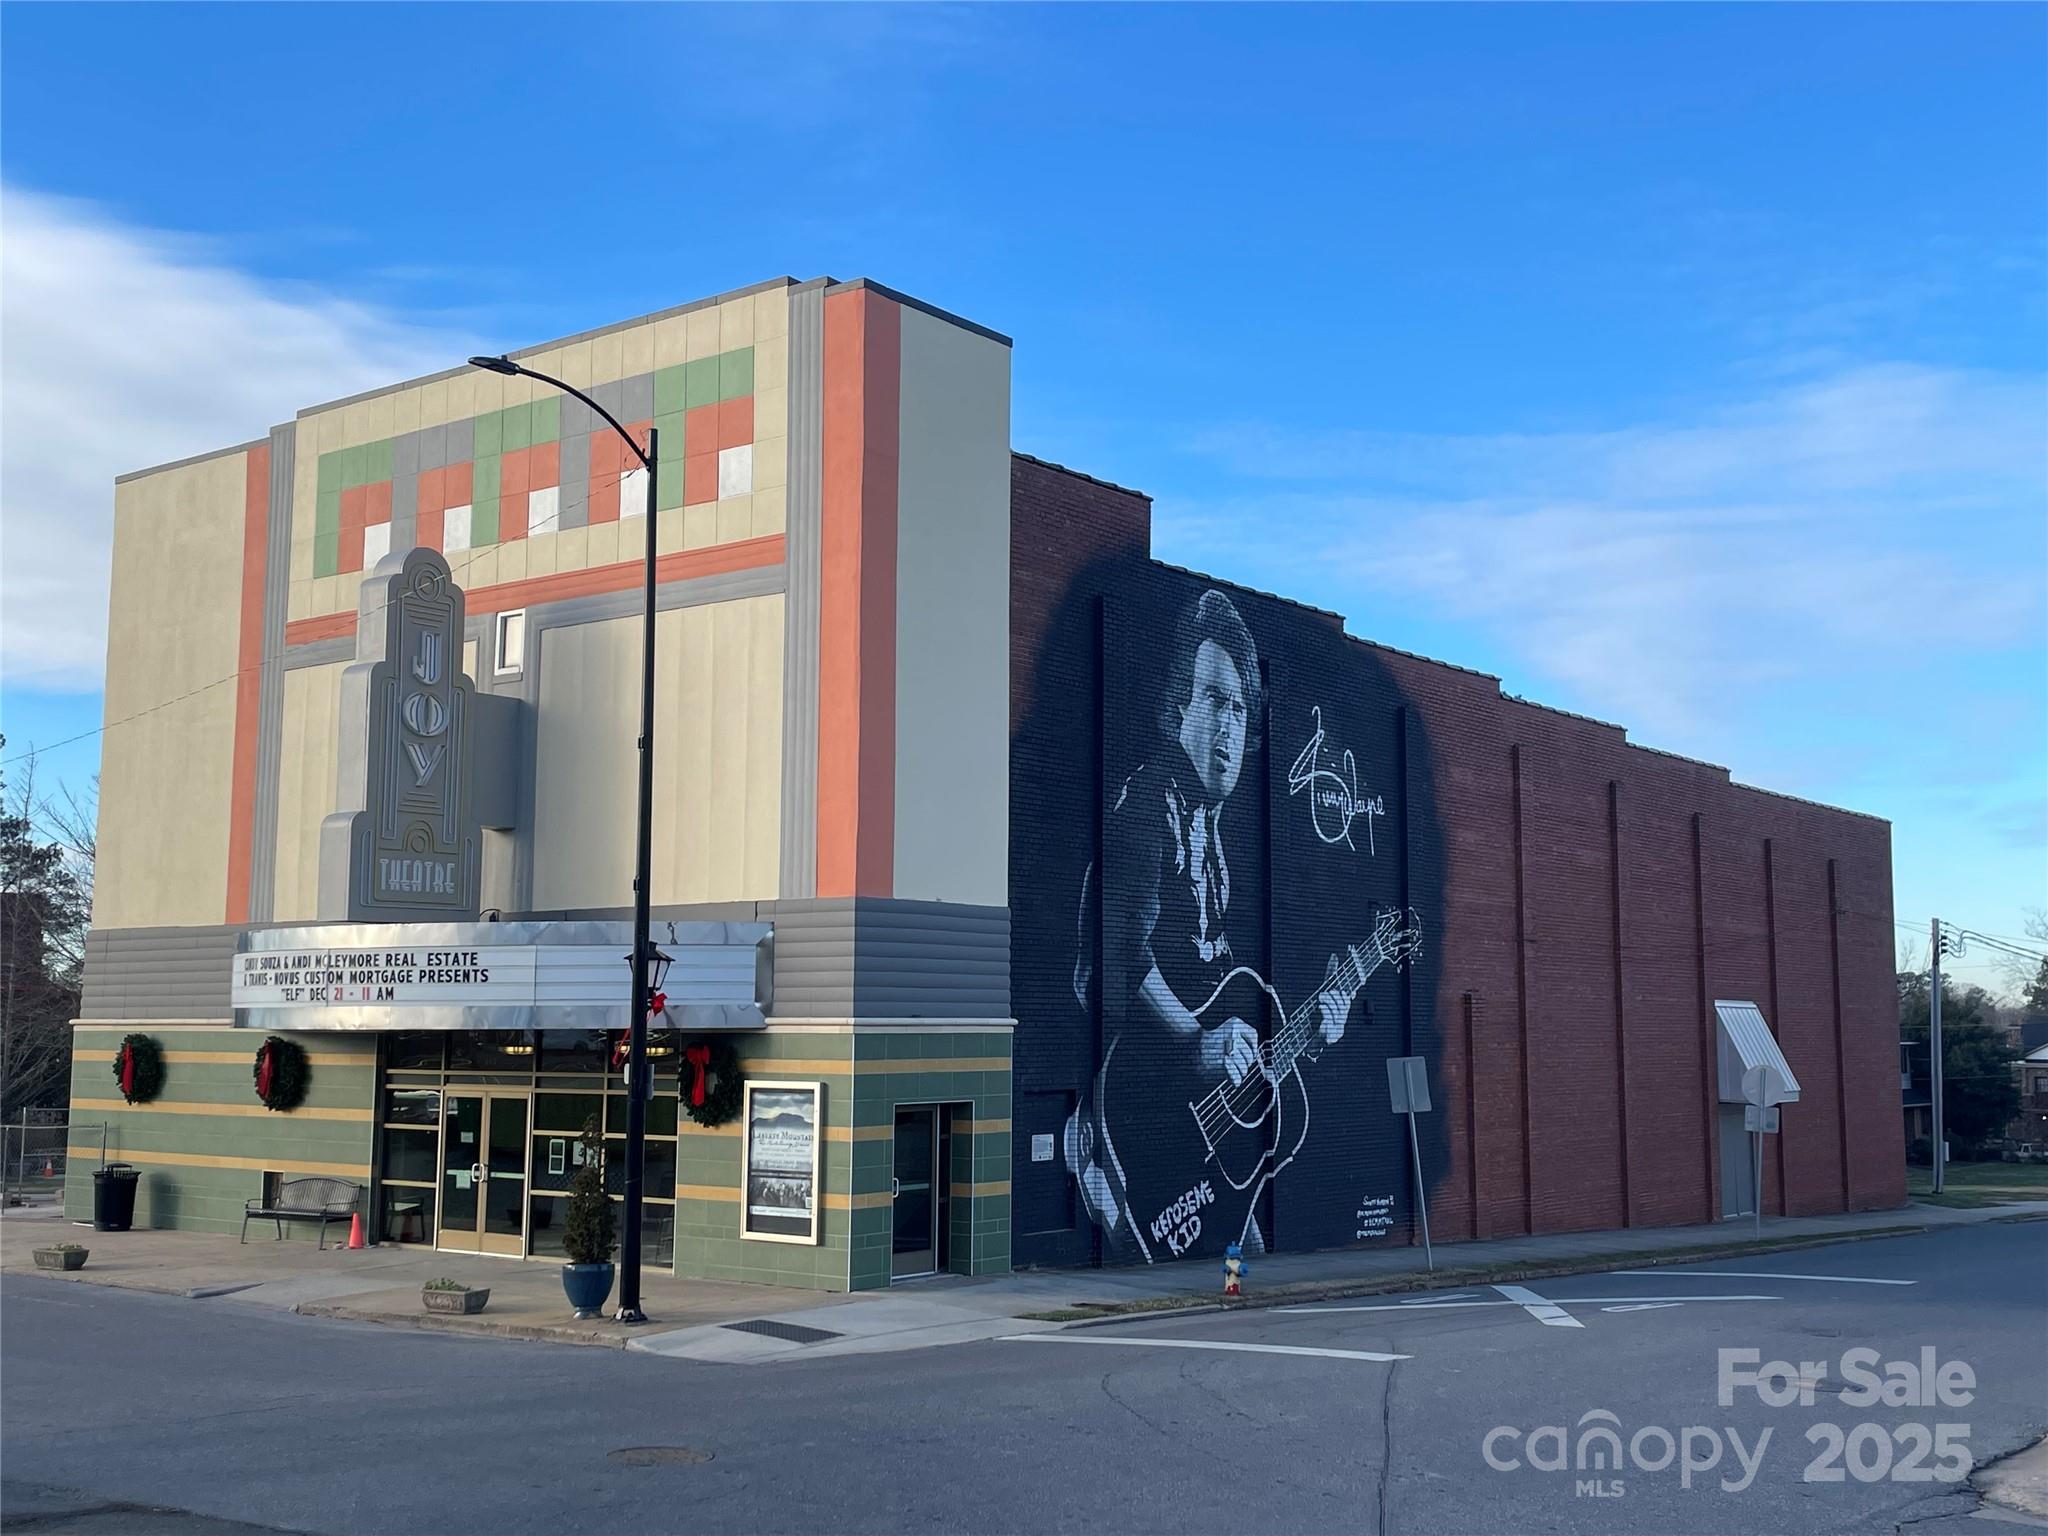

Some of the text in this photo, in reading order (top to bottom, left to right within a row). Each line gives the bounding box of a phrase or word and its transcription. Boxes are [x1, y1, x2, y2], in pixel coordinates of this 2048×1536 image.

[401, 630, 449, 787] JOY
[379, 859, 455, 894] THEATRE
[260, 957, 281, 970] SOUZA
[284, 956, 289, 969] &
[292, 955, 311, 969] ANDI
[385, 953, 417, 967] REAL
[427, 952, 478, 966] ESTATE
[275, 971, 299, 985] NOVUS
[304, 971, 343, 985] CUSTOM
[349, 970, 413, 984] MORTGAGE
[419, 969, 489, 983] PRESENTS
[281, 987, 304, 1001] "ELF"
[310, 987, 326, 1001] DEC
[334, 987, 343, 1001] 21
[362, 987, 370, 1001] 11
[377, 986, 394, 1001] AM
[1167, 1216, 1201, 1258] KID
